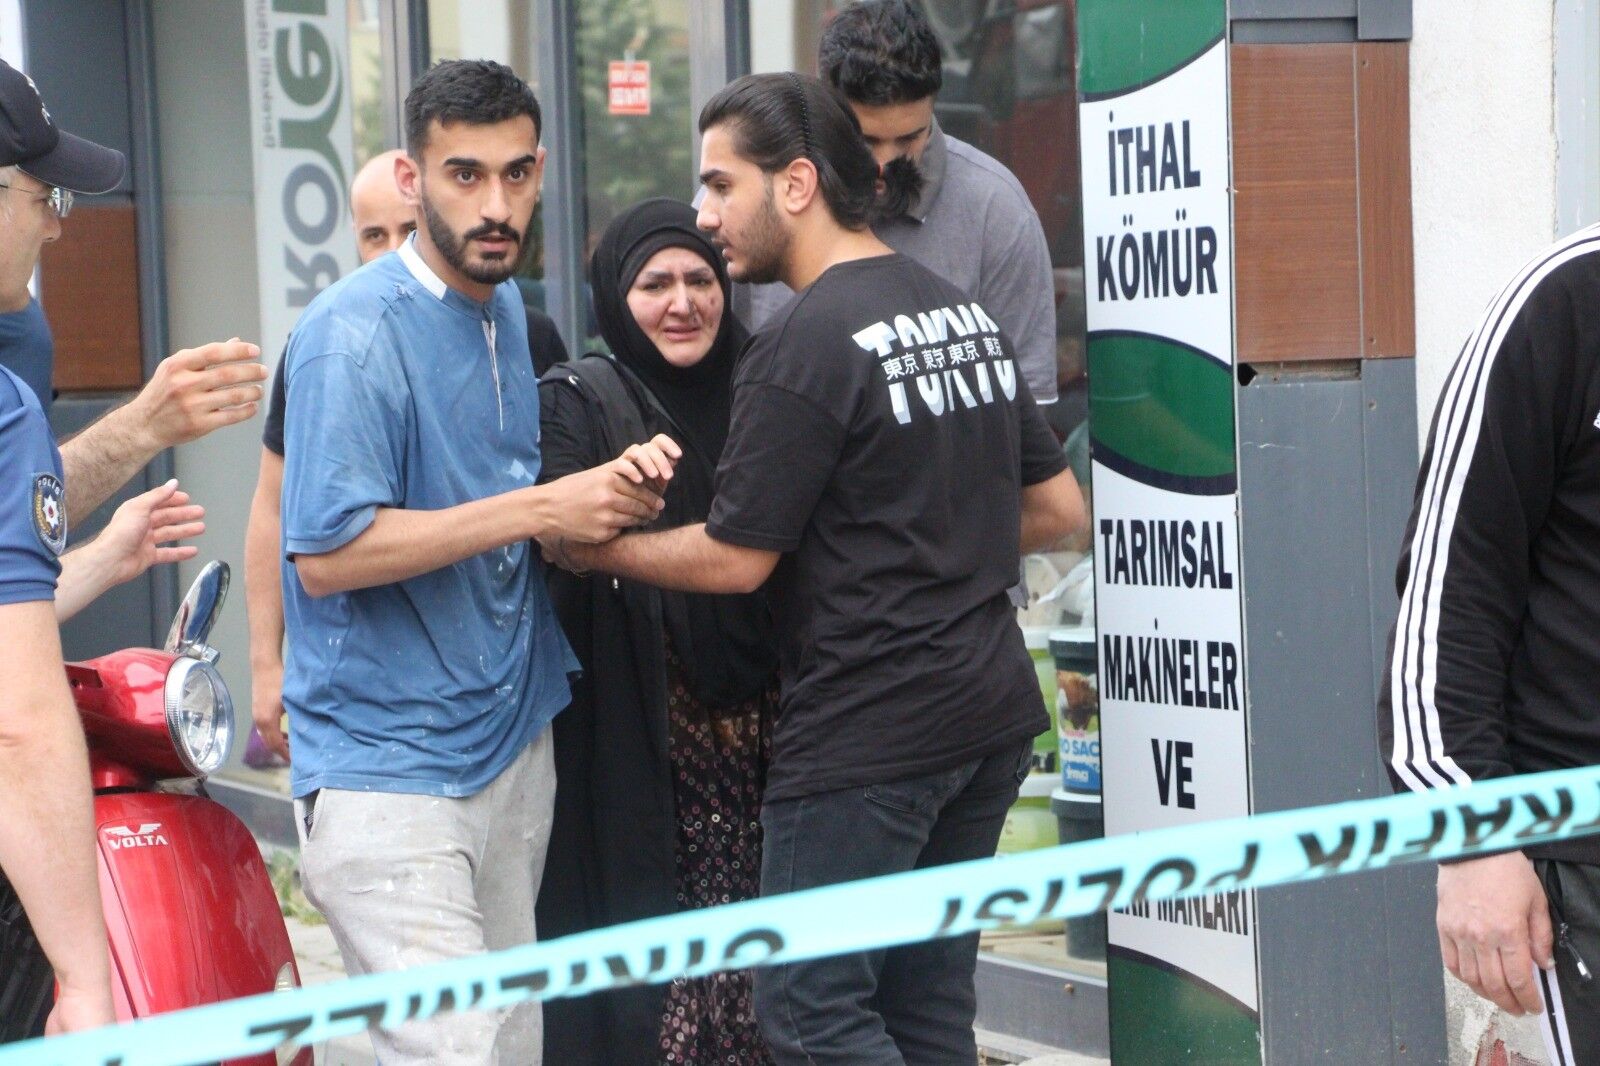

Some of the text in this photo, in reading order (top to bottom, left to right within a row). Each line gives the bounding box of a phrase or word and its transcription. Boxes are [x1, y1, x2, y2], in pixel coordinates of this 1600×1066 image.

[1108, 110, 1200, 196] İTHAL
[1097, 208, 1218, 301] KÖMÜR
[1100, 519, 1233, 590] TARIMSAL
[1102, 618, 1239, 711] MAKİNELER
[1151, 738, 1196, 810] VE
[107, 835, 168, 850] VOLTA
